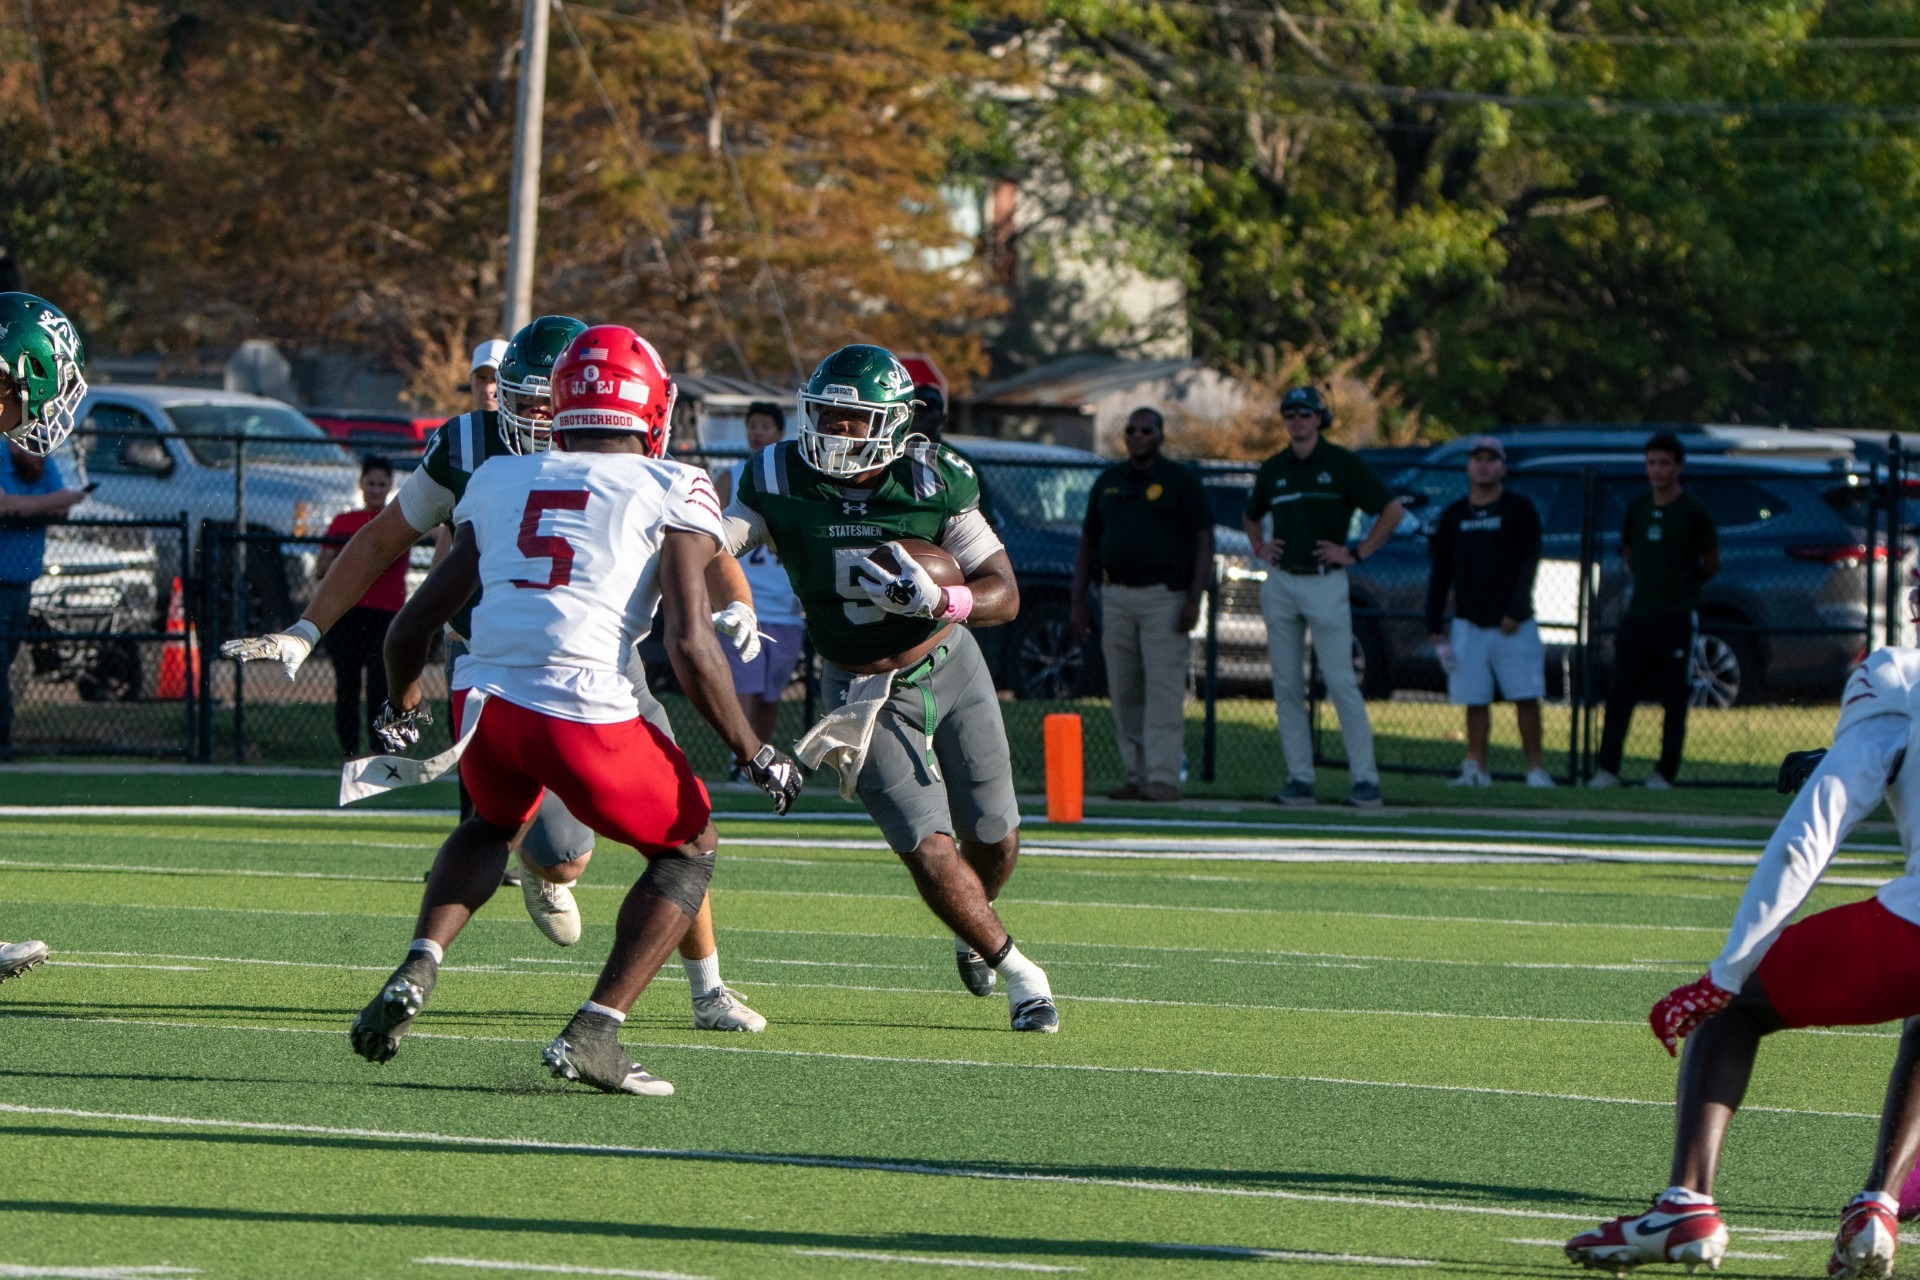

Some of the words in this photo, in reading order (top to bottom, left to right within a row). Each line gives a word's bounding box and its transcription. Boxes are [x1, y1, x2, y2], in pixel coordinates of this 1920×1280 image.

[588, 368, 595, 379] 5
[572, 381, 586, 395] JJ
[596, 381, 614, 395] EJ
[560, 413, 633, 428] BROTHERHOOD
[944, 450, 975, 479] 5
[829, 525, 882, 538] STATESMEN
[509, 489, 591, 591] 5
